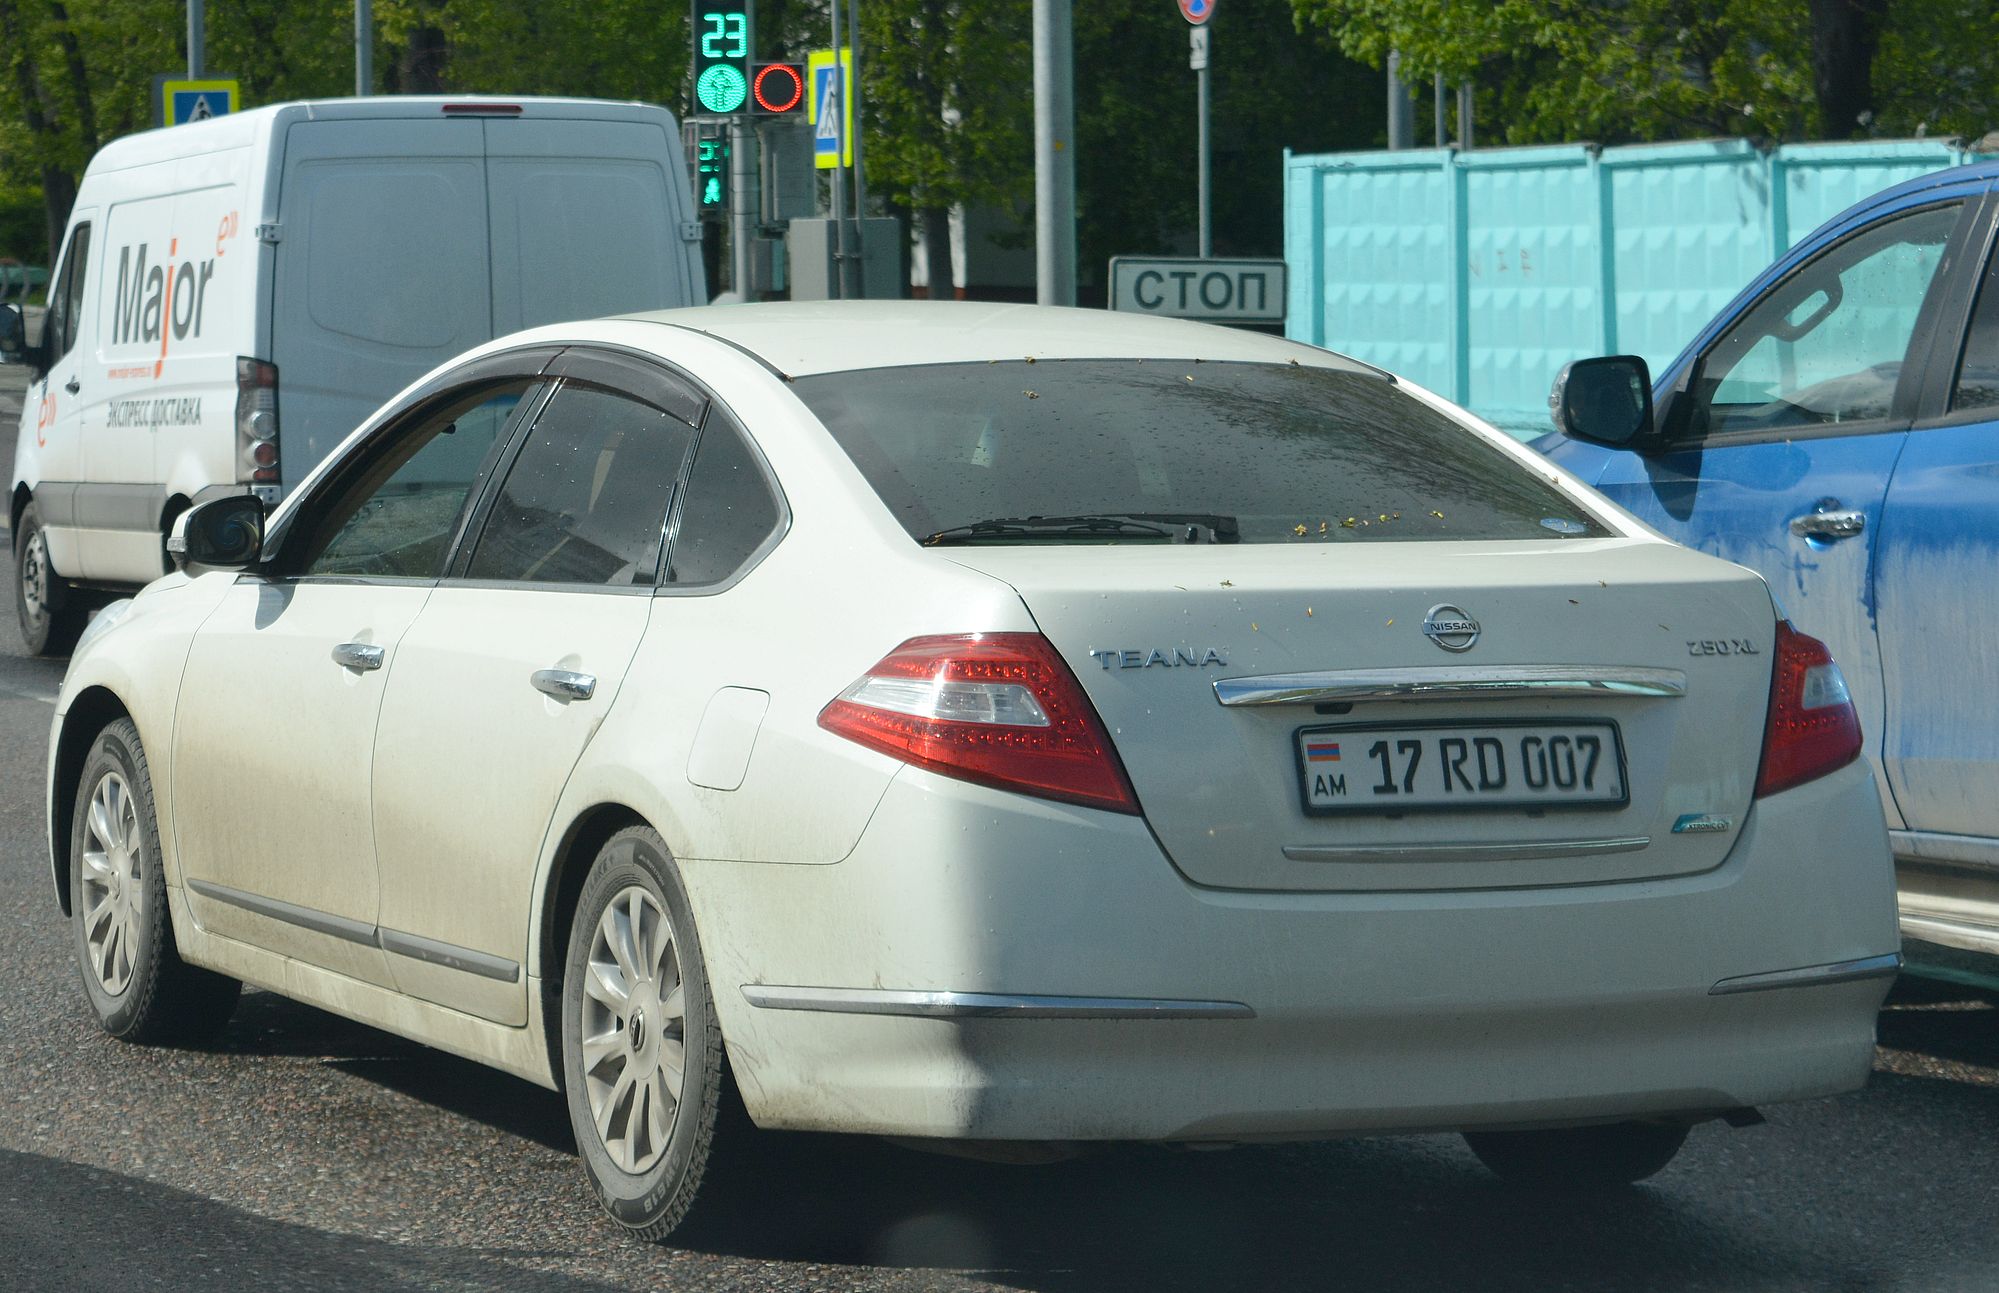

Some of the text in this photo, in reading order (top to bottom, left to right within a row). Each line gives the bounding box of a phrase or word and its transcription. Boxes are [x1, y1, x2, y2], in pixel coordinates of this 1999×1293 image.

[702, 13, 747, 58] 23
[112, 238, 215, 379] Major
[1134, 270, 1266, 310] СТОП
[106, 397, 202, 433] ЭКСПРЕСС ДОСТАВКА
[1430, 622, 1477, 632] NISSAN
[1089, 646, 1228, 670] TEANA
[1368, 734, 1601, 794] 17 RD 007
[1314, 773, 1347, 797] AM
